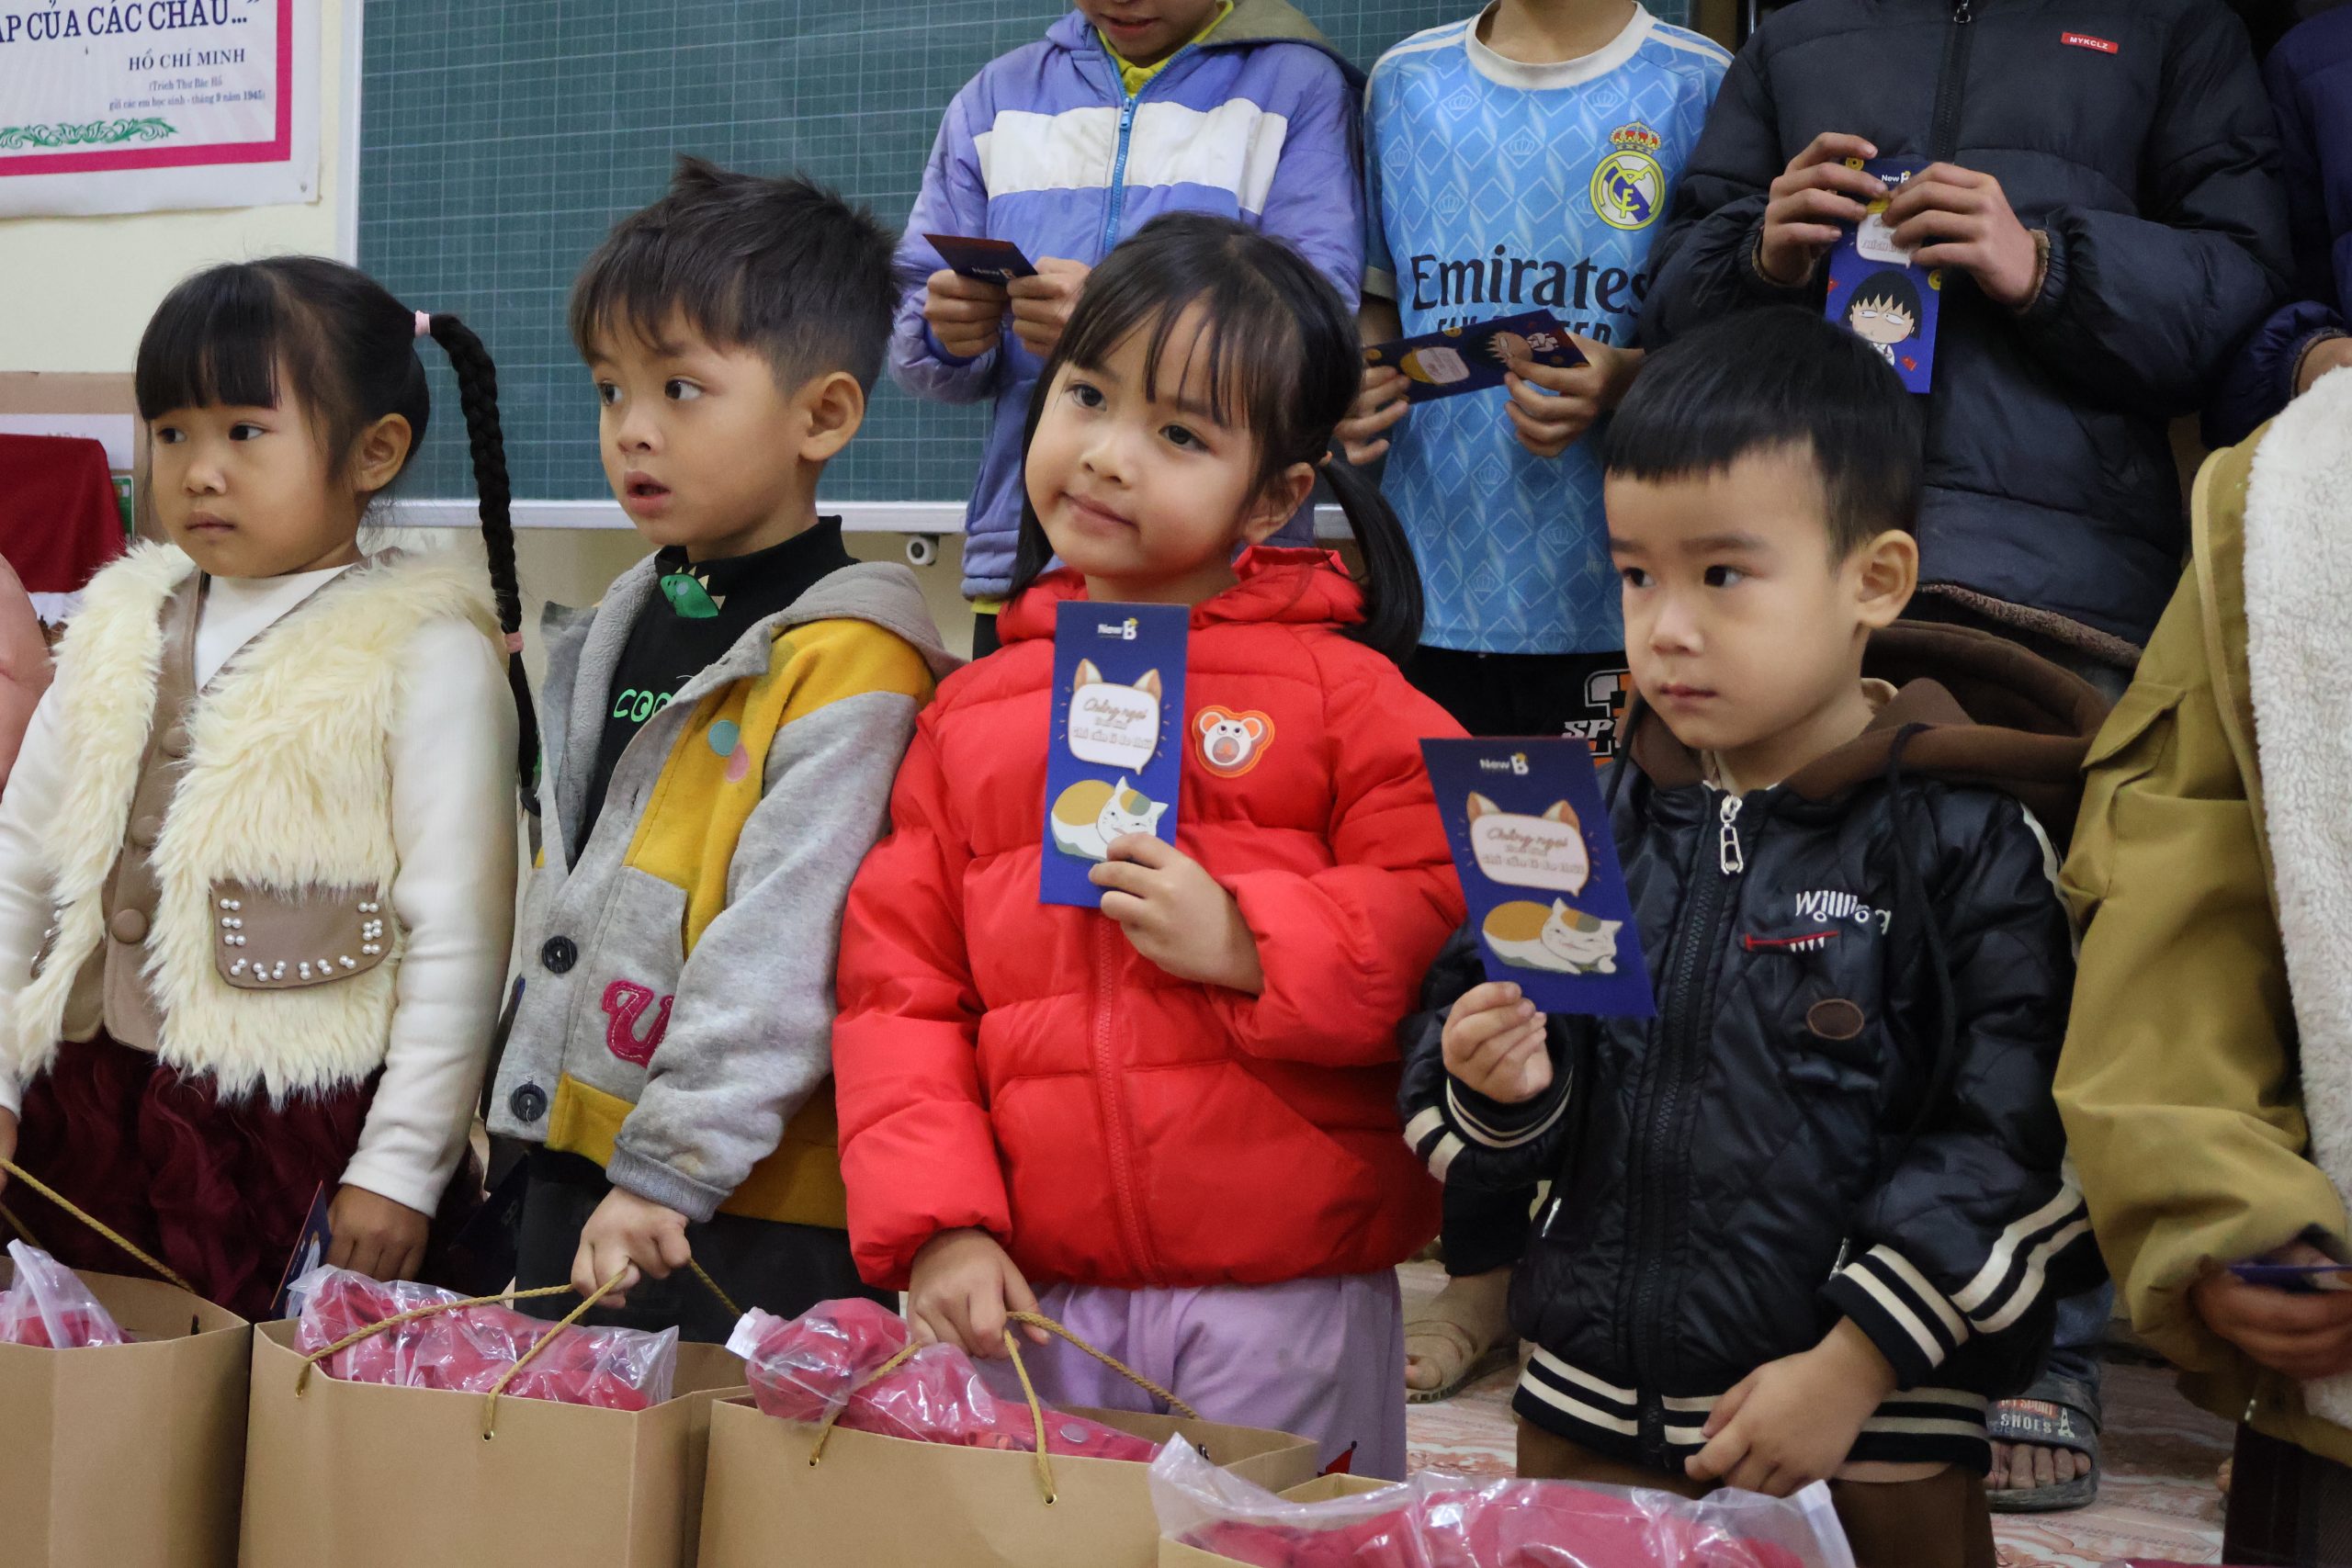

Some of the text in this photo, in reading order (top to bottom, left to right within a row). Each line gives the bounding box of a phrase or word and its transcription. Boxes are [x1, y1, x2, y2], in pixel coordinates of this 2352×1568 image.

[27, 0, 82, 41] CỦA
[2070, 36, 2109, 50] MYKCLZ
[160, 48, 192, 69] CHÍ
[198, 48, 245, 67] MINH
[1882, 175, 1900, 183] New
[1479, 759, 1510, 769] New
[2000, 1413, 2052, 1434] SHOES
